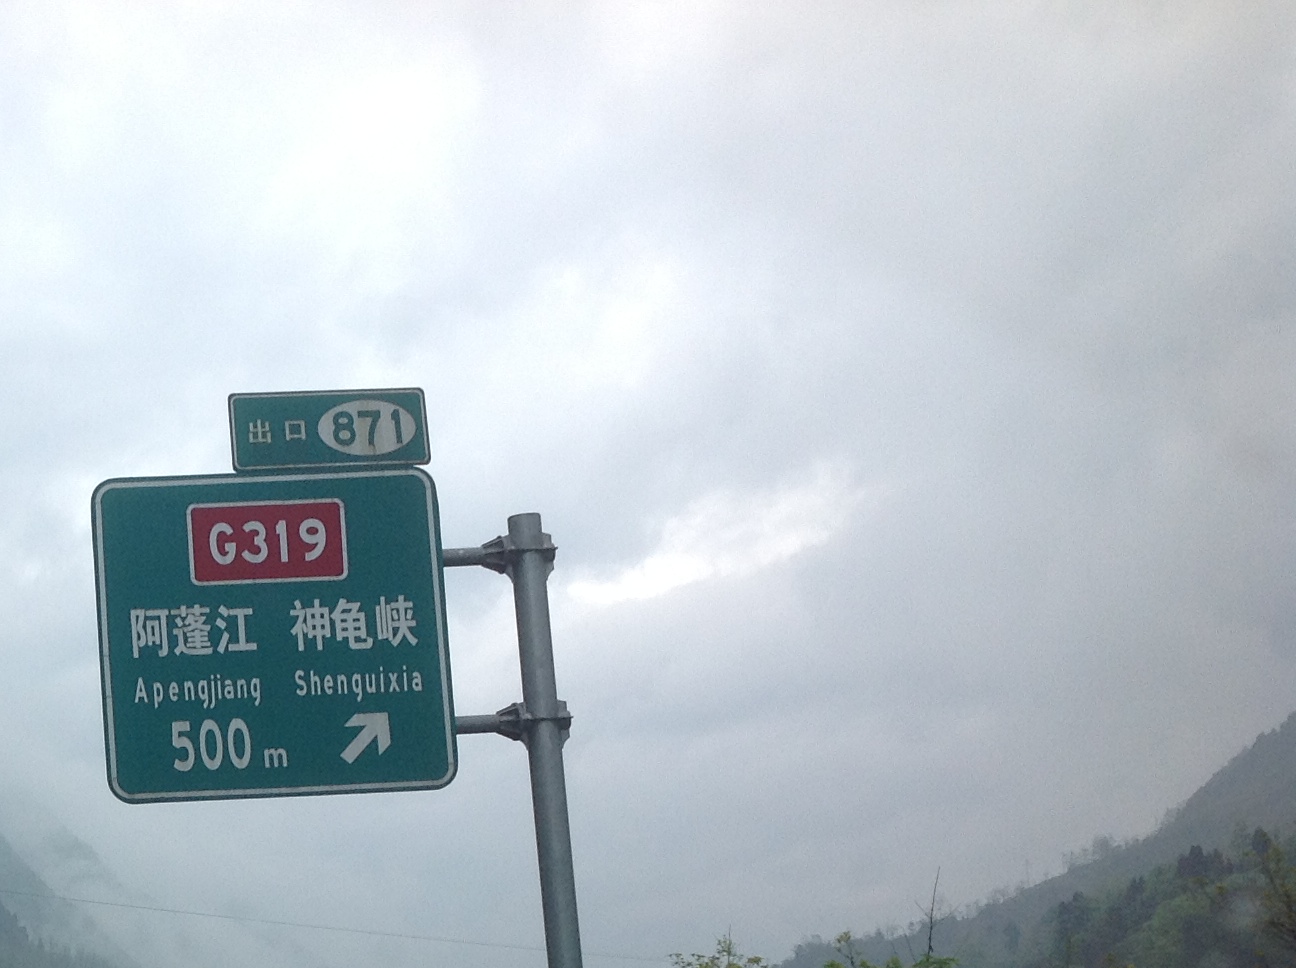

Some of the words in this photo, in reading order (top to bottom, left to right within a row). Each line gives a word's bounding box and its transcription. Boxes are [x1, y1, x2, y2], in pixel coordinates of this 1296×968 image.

[248, 418, 307, 445] 出口
[332, 409, 404, 448] 871
[208, 517, 328, 566] G319
[130, 603, 258, 658] 阿蓬江
[290, 594, 418, 652] 神龟峡
[134, 674, 262, 710] Apengjiang
[294, 665, 423, 702] Shenguixia
[171, 717, 252, 772] 500
[263, 743, 289, 769] m
